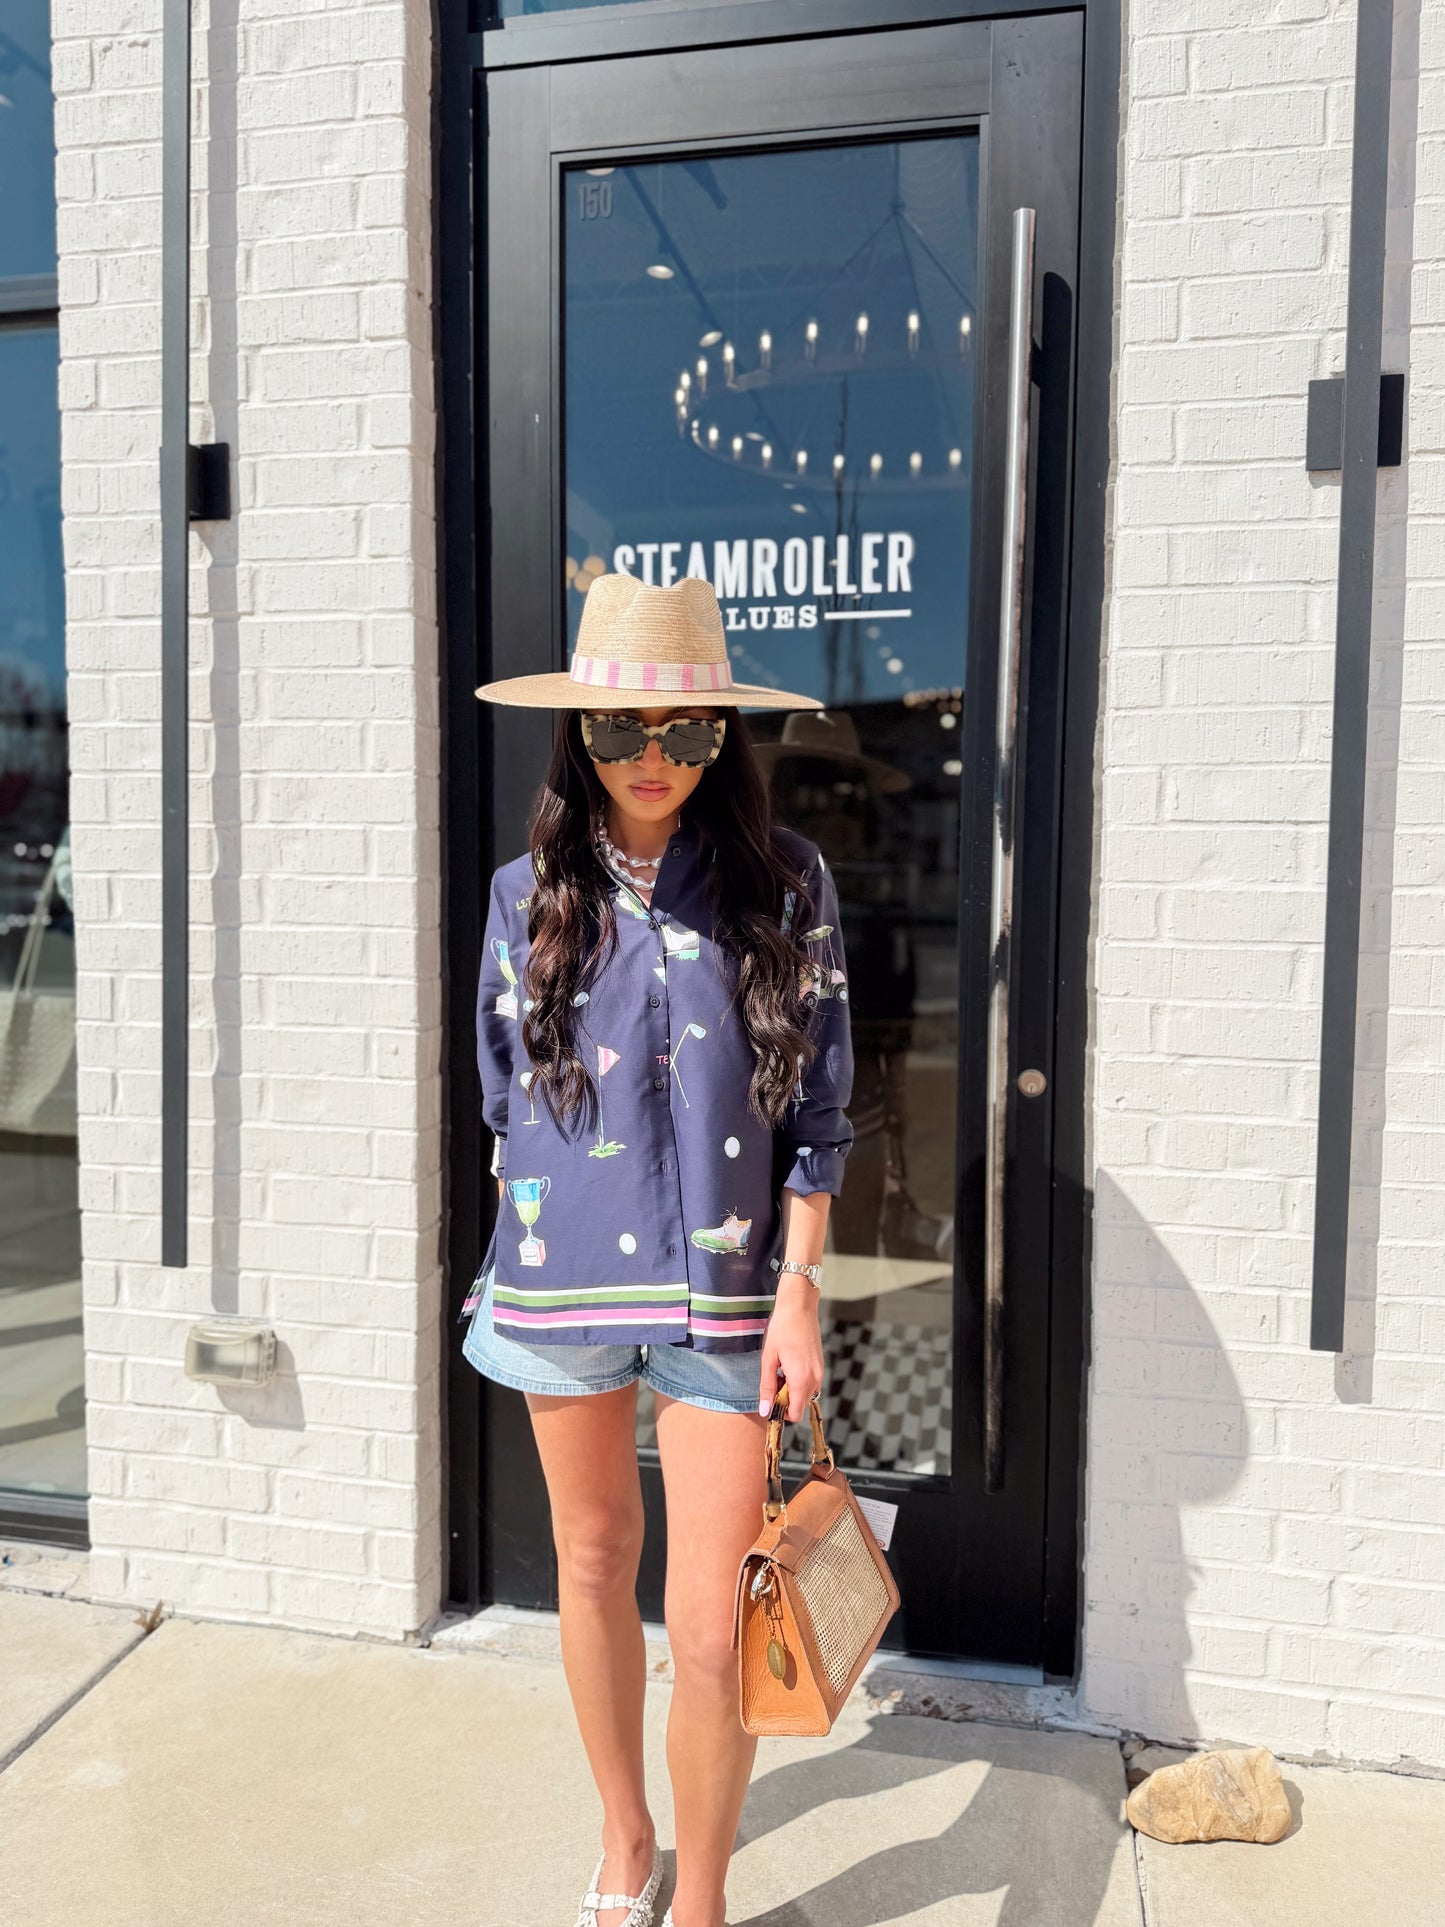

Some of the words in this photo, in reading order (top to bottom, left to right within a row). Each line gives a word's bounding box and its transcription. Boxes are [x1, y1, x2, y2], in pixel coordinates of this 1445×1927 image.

[580, 181, 613, 220] 150
[613, 531, 914, 600] STEAMROLLER
[720, 604, 818, 631] LUES
